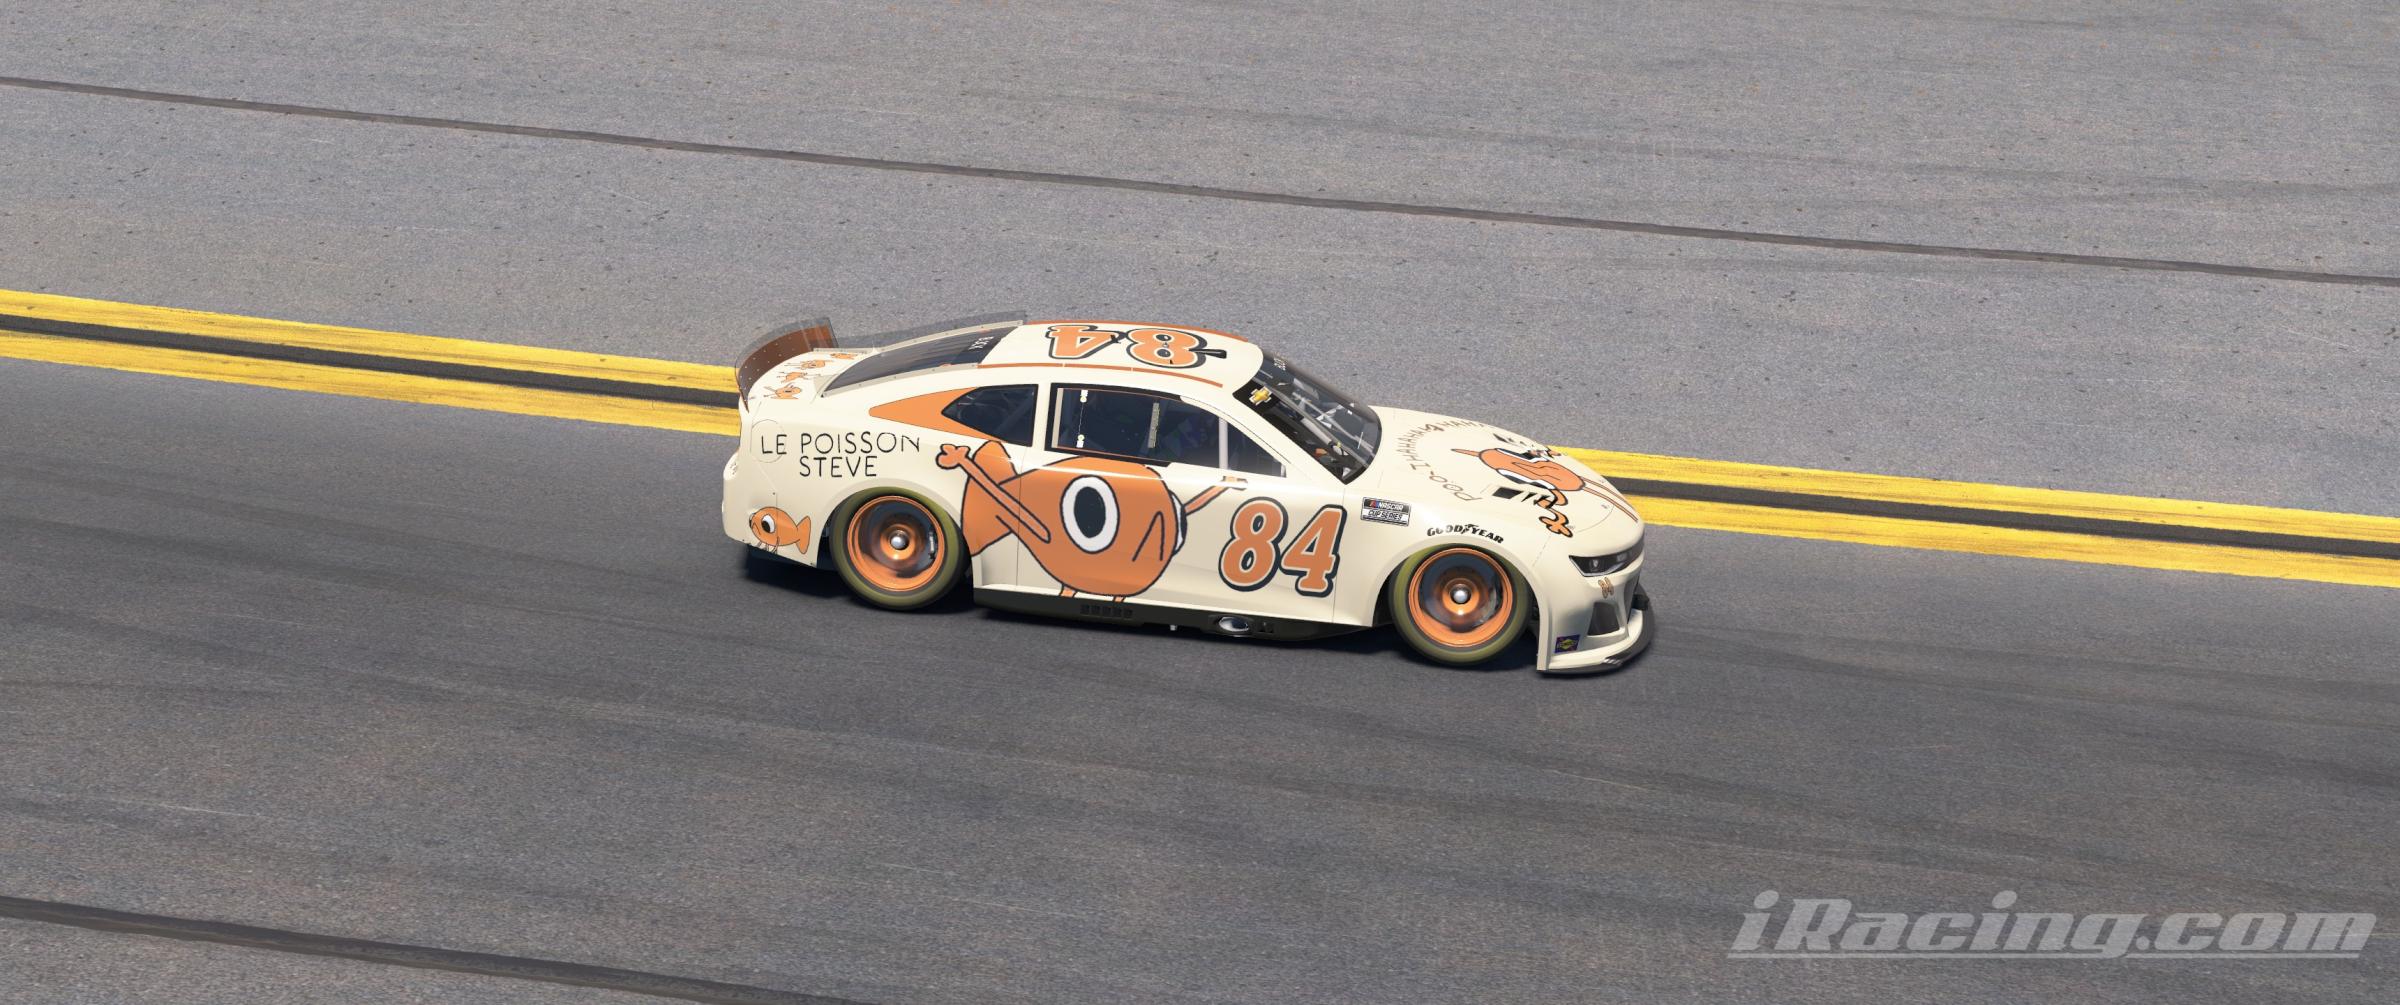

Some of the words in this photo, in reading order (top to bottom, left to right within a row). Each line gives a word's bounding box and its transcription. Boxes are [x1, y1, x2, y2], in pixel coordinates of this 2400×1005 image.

[1045, 324, 1208, 369] 84
[761, 432, 787, 455] LE
[801, 431, 920, 454] POISSON
[799, 455, 877, 478] STEVE
[1368, 509, 1381, 517] CUP
[1381, 511, 1402, 520] SERIES
[1378, 500, 1404, 511] NASCAR
[1427, 523, 1504, 544] GOODYEAR
[1218, 497, 1347, 597] 84
